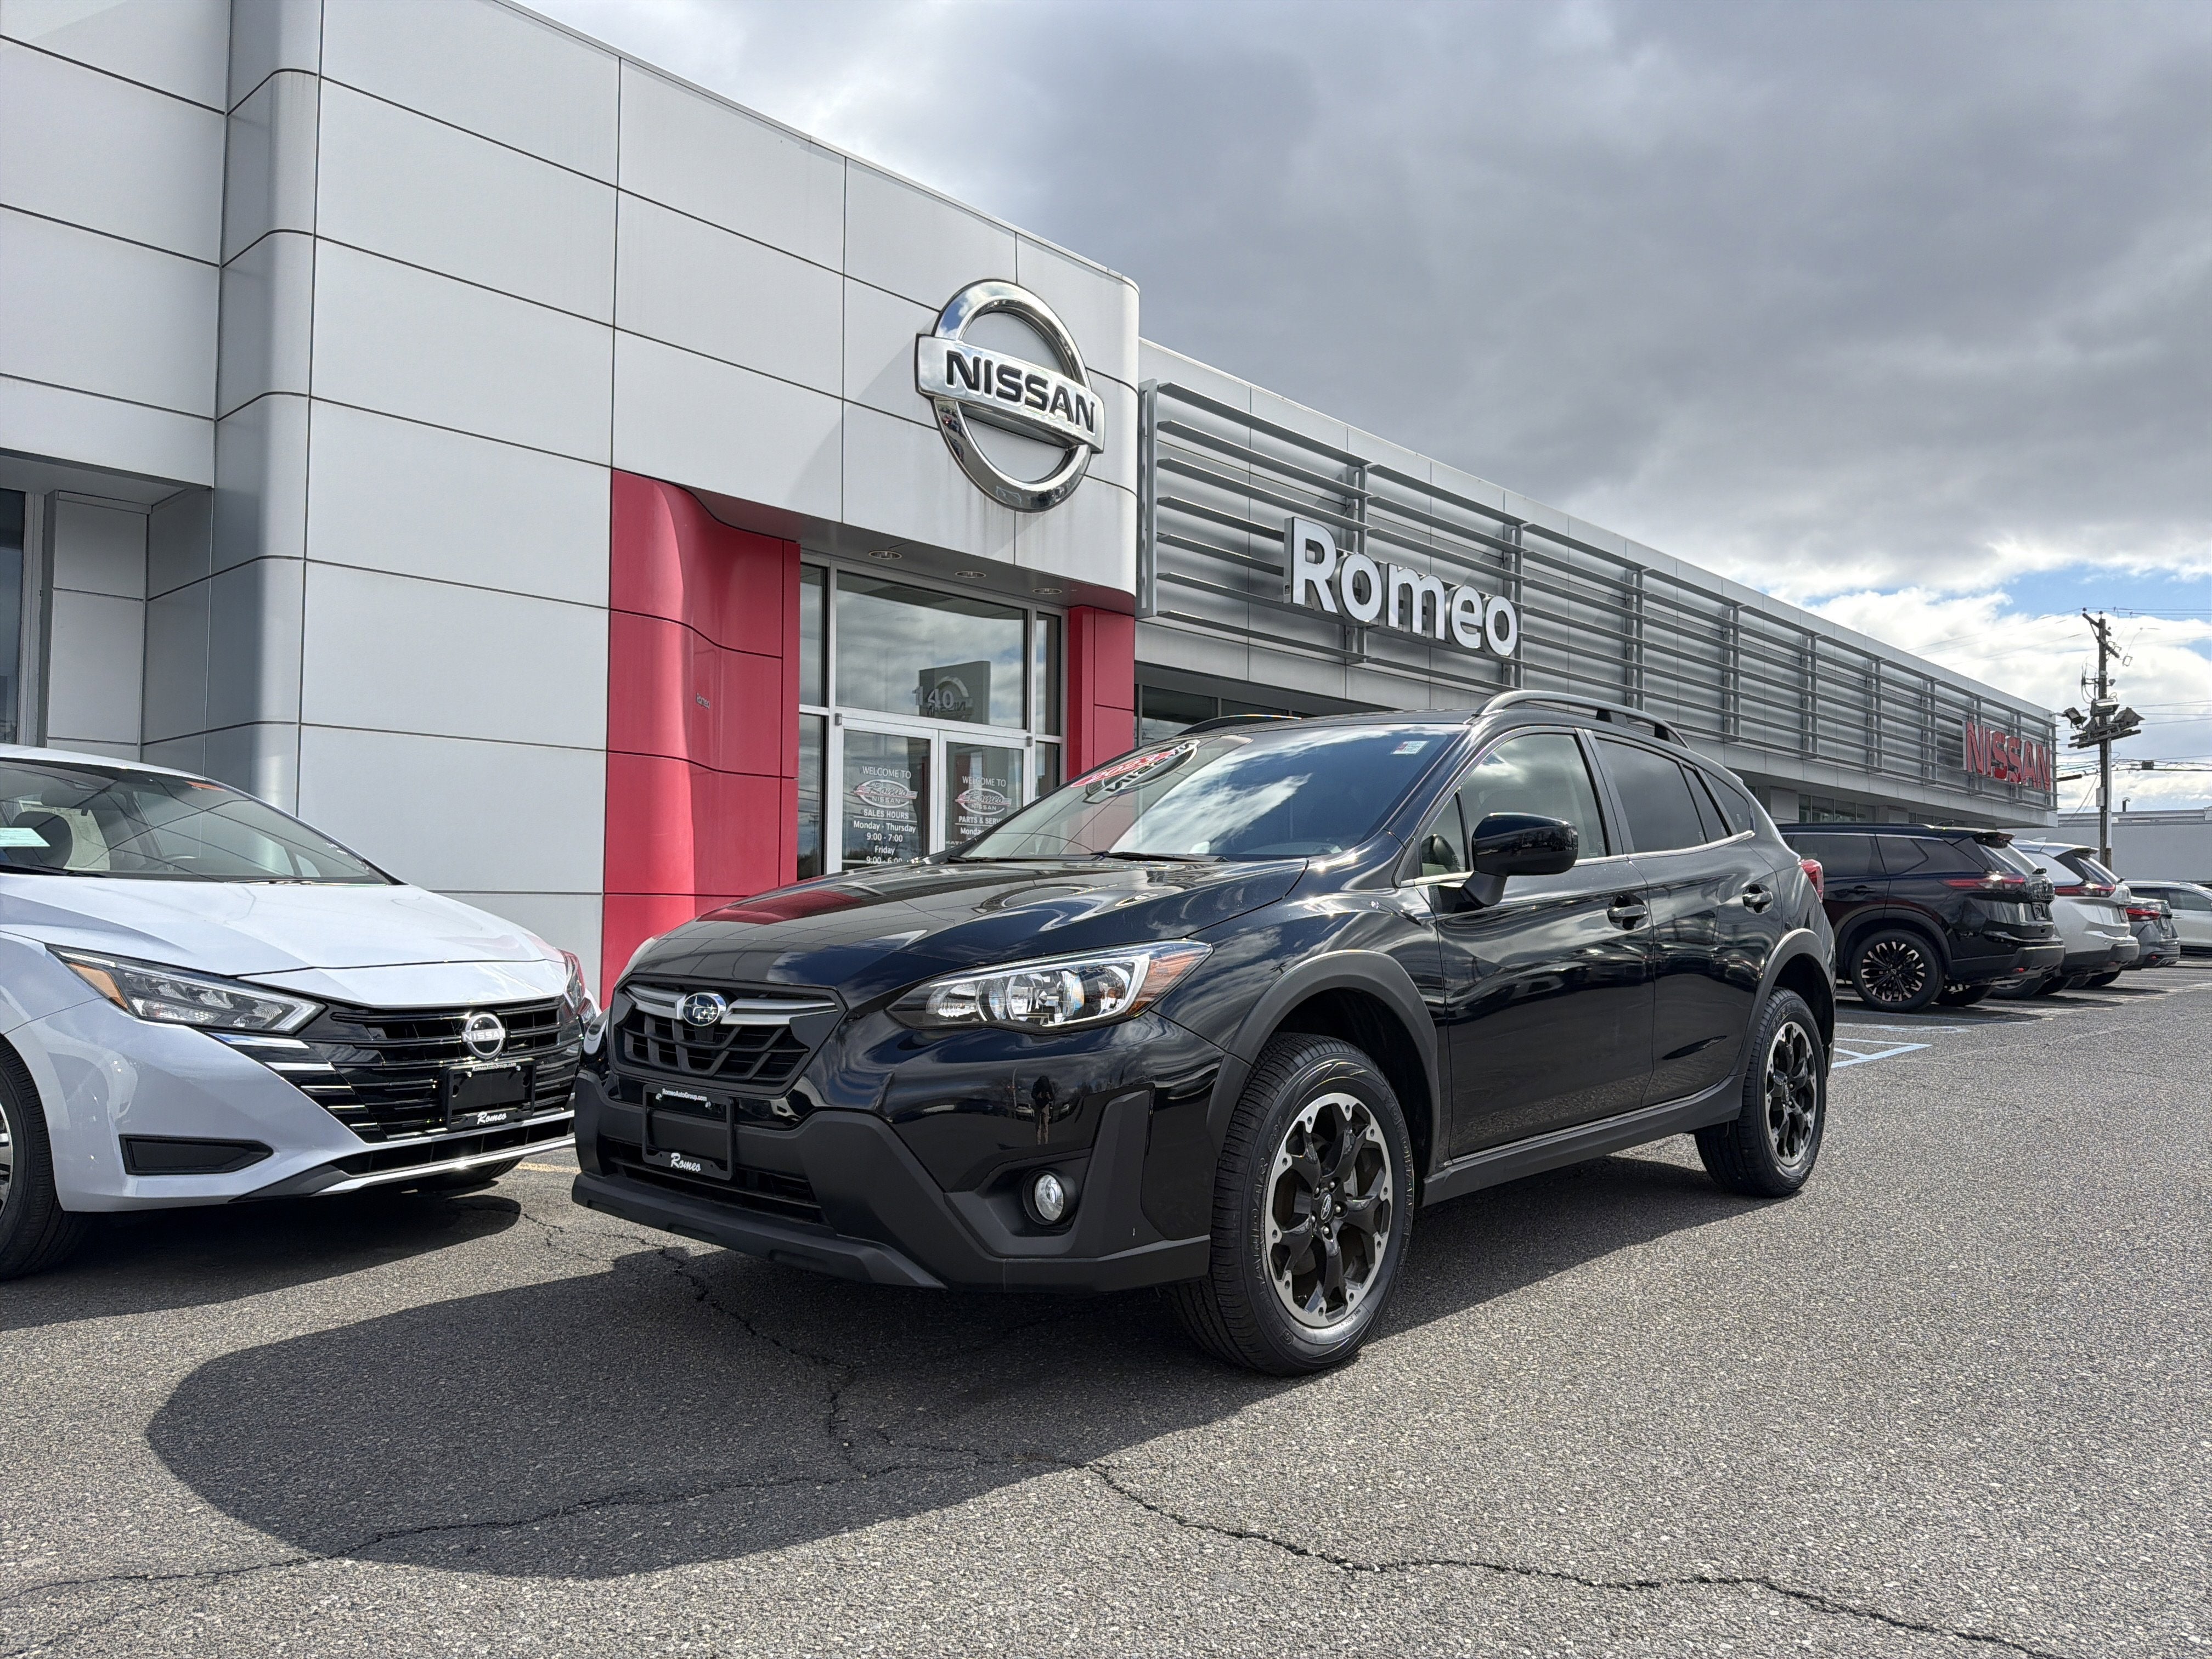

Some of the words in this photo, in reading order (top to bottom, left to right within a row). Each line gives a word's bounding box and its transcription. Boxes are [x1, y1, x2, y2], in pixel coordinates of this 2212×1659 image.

[945, 350, 1095, 436] NISSAN
[1285, 516, 1517, 656] Romeo
[912, 686, 953, 708] 140
[1963, 721, 2051, 792] NISSAN
[862, 766, 899, 778] WELCOME
[901, 770, 911, 779] TO
[962, 776, 995, 786] WELCOME
[996, 779, 1006, 787] TO
[867, 781, 908, 796] Romeo
[872, 796, 901, 804] NISSAN
[968, 790, 1003, 804] Romeo
[864, 809, 884, 817] SALES
[854, 820, 880, 832] Monday
[886, 822, 916, 834] Thursday
[866, 833, 882, 841] 9:00
[874, 845, 895, 856] Friday
[866, 856, 882, 865] 9:00
[463, 1030, 505, 1041] NISSAN
[662, 1088, 707, 1101] RomeoAutoGroup.com
[477, 1111, 507, 1125] Romeo
[670, 1153, 701, 1172] Romeo
